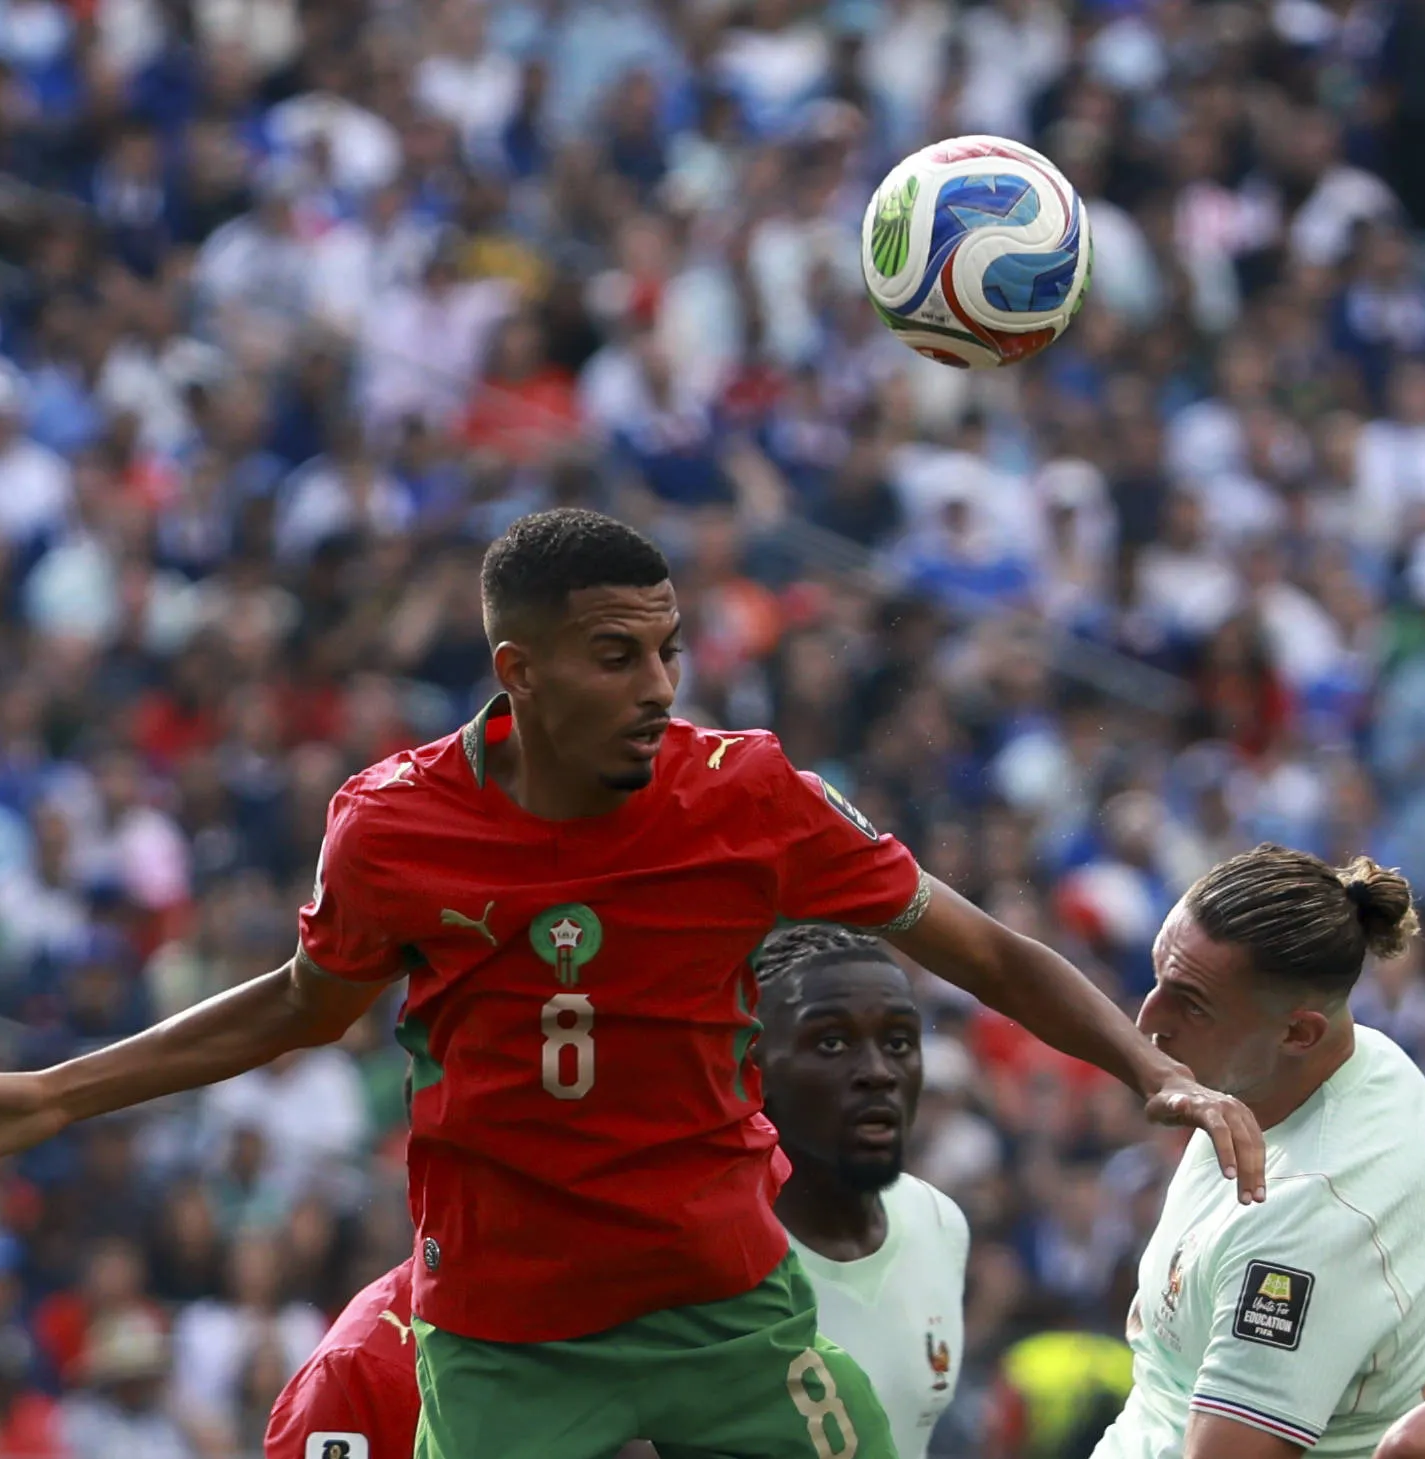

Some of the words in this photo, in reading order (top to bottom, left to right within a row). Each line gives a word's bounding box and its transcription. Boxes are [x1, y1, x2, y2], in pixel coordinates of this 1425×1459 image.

[541, 993, 594, 1099] 8
[1244, 1310, 1293, 1332] EDUCATION
[1255, 1327, 1273, 1337] FIFA
